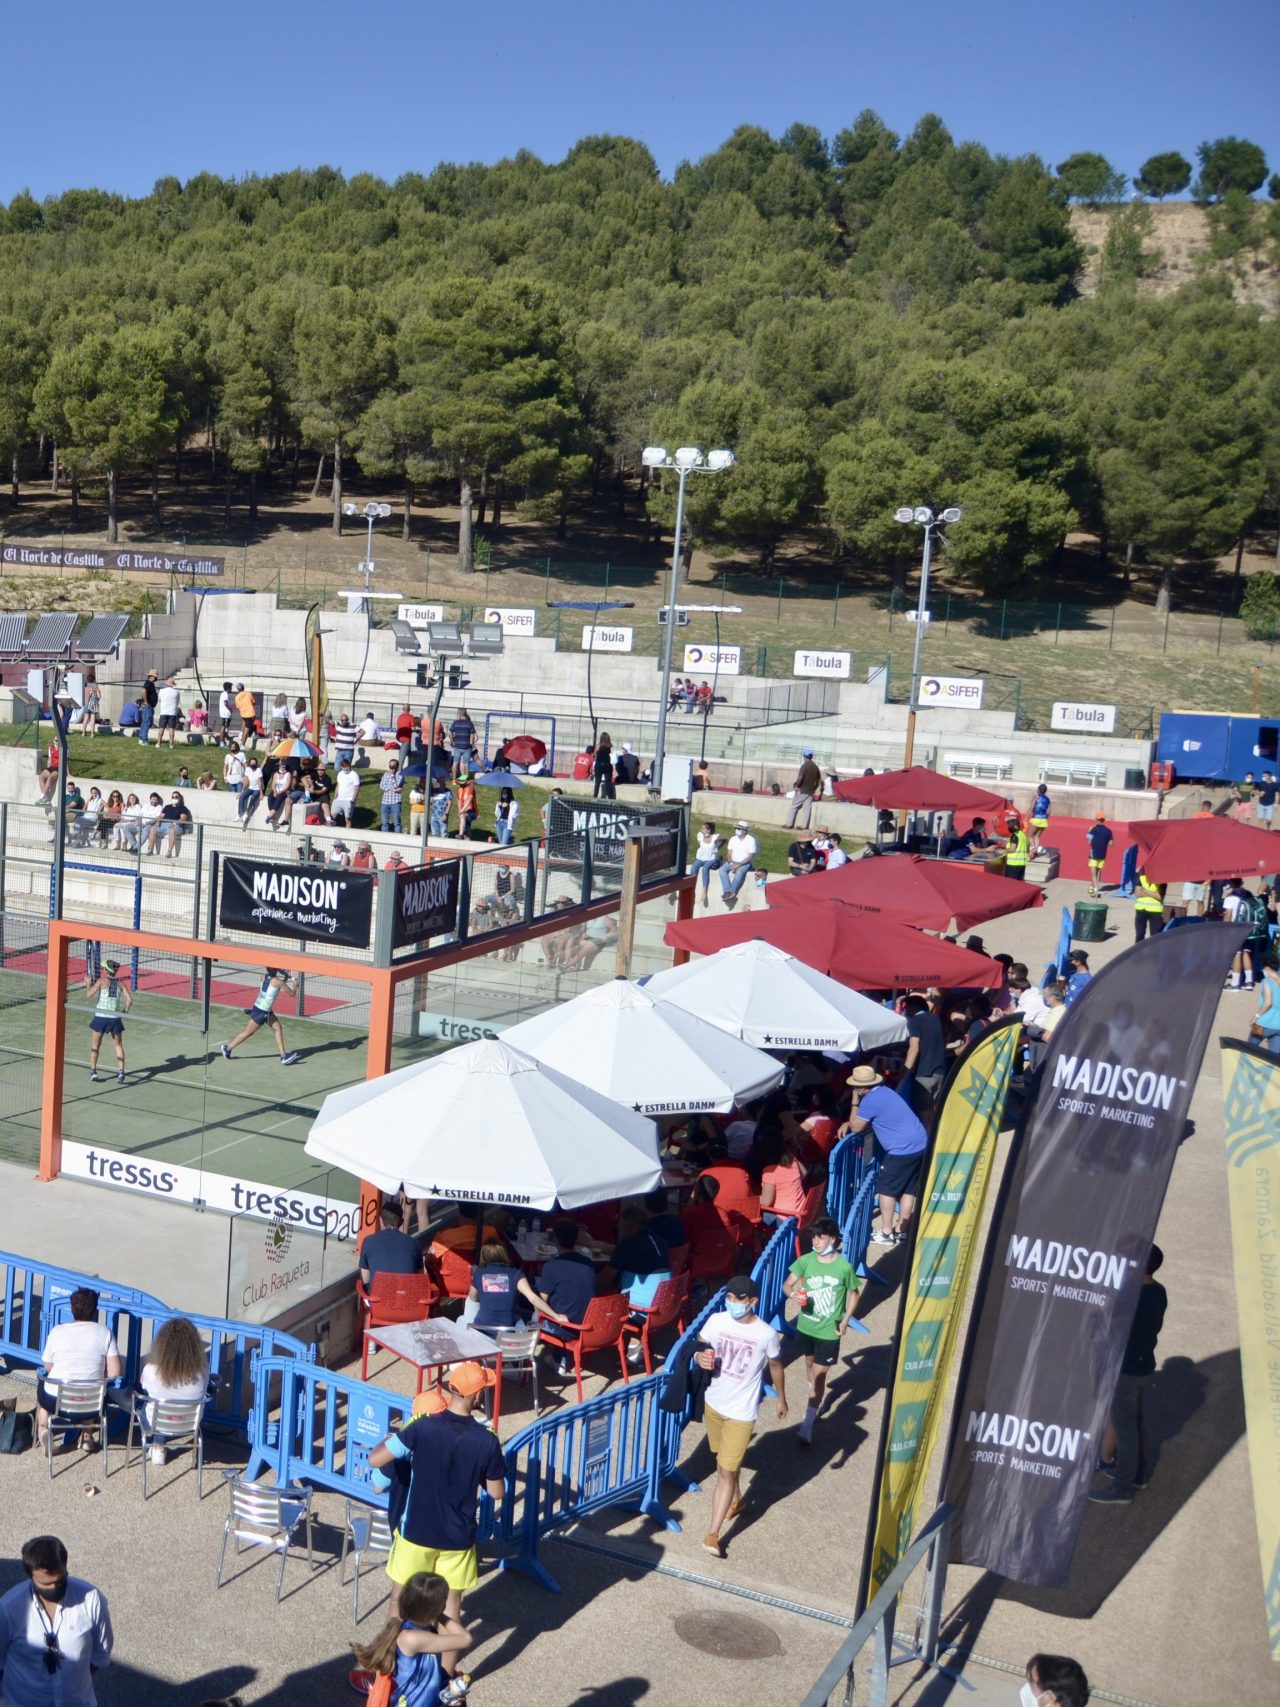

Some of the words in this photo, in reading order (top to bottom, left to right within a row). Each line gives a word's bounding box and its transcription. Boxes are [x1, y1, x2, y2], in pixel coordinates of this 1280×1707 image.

[3, 548, 17, 561] El
[20, 549, 48, 564] Norte
[51, 551, 62, 564] de
[64, 552, 105, 567] Castilla
[117, 553, 130, 568] El
[133, 554, 162, 569] Norte
[164, 557, 176, 570] de
[177, 559, 218, 574] Castilla
[502, 615, 533, 626] ASIFER
[940, 685, 980, 698] ASIFER
[573, 810, 629, 841] MADIS
[252, 871, 339, 910] MADISON
[402, 874, 450, 918] MADISON
[251, 908, 294, 924] experience
[297, 912, 340, 934] marketing
[439, 1017, 494, 1041] tress
[775, 1036, 812, 1046] ESTRELLA
[814, 1038, 839, 1047] DAMM
[1052, 1053, 1177, 1111] MADISON
[645, 1102, 686, 1113] ESTRELLA
[688, 1101, 716, 1111] DAMM
[1057, 1097, 1096, 1116] SPORTS
[1099, 1105, 1156, 1129] MARKETING
[86, 1151, 176, 1193] tressis
[231, 1183, 329, 1228] tressis
[445, 1188, 494, 1201] ESTRELLA
[497, 1193, 531, 1204] DAMM
[325, 1194, 378, 1242] pade
[1004, 1234, 1128, 1290] MADISON
[242, 1281, 268, 1308] Club
[270, 1260, 310, 1293] Raqueta
[1010, 1276, 1048, 1294] SPORTS
[1052, 1284, 1106, 1307] MARKETING
[716, 1337, 753, 1374] NYC
[965, 1410, 1081, 1462] MADISON
[970, 1449, 1006, 1466] SPORTS
[1009, 1456, 1062, 1479] MARKETING
